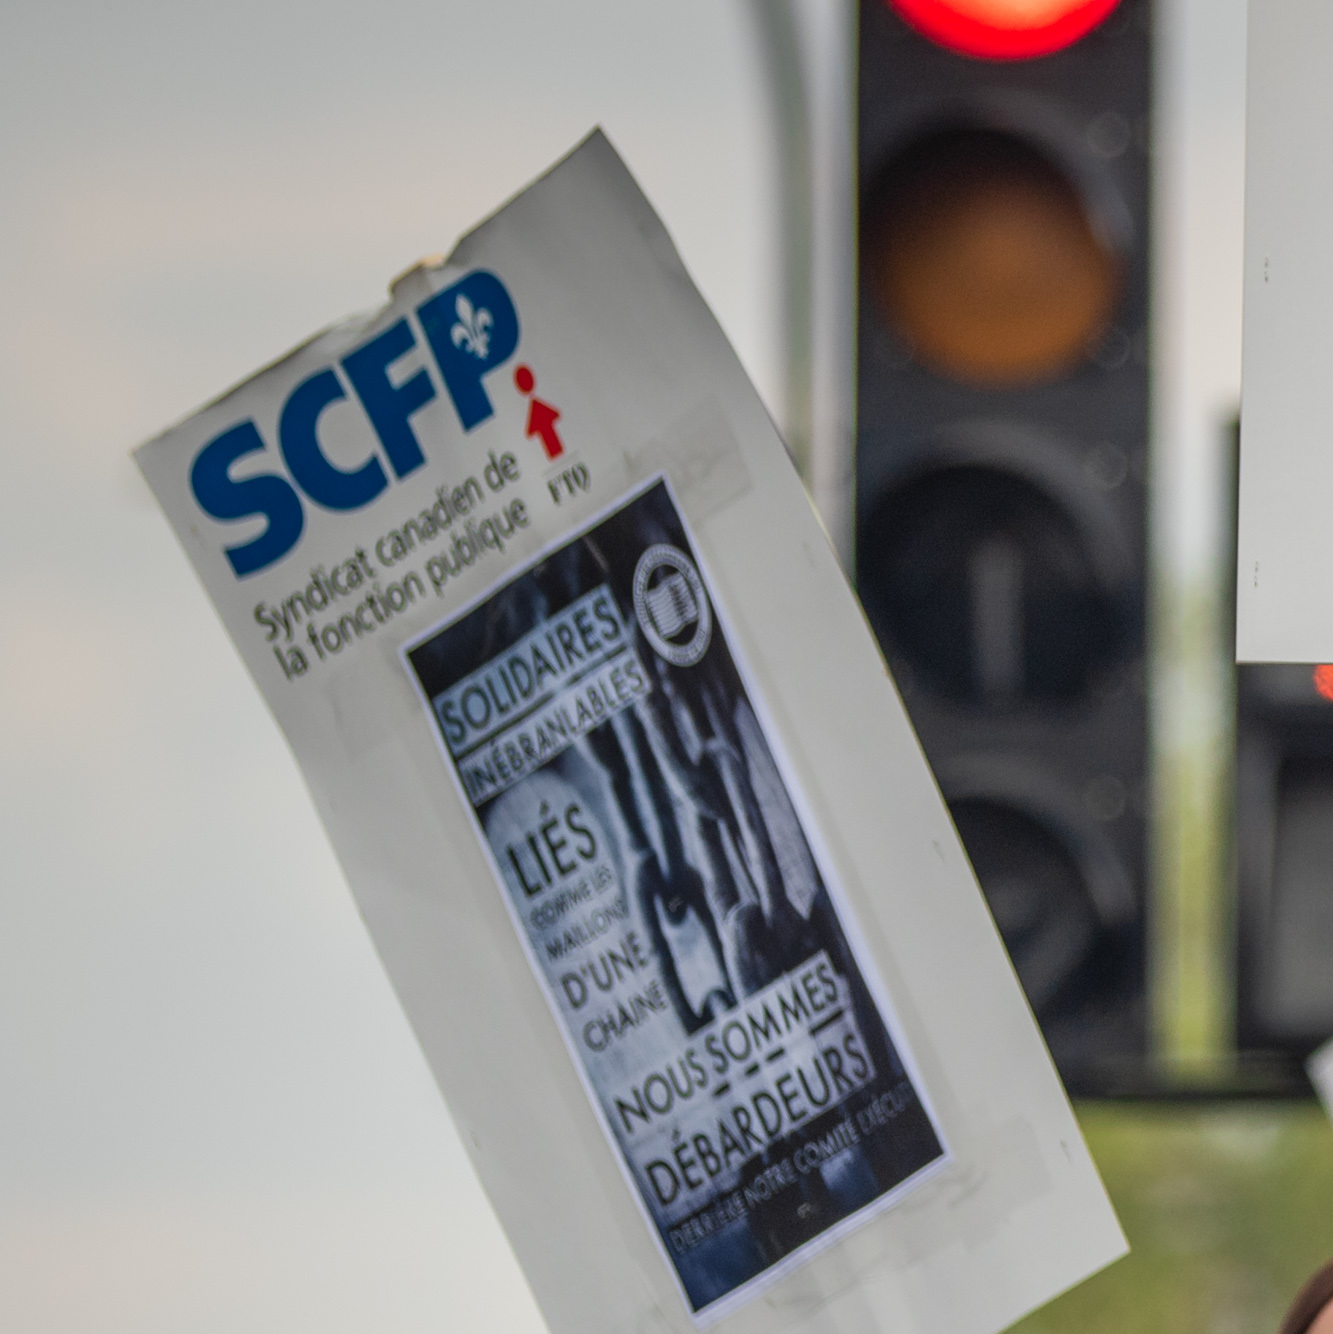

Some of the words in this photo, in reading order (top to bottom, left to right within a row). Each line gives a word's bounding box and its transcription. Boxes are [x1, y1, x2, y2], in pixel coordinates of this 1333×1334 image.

[188, 267, 521, 581] SCFP
[254, 544, 378, 642] Syndicat
[374, 475, 486, 569] canadien
[484, 449, 521, 493] de
[273, 643, 311, 681] la
[305, 571, 427, 662] fonction
[424, 498, 531, 597] publique
[441, 597, 621, 744] SOLIDAIRES
[464, 660, 645, 798] INÉBRANLABLES
[506, 800, 598, 898] LIÉS
[560, 931, 649, 1009] D'UNE
[613, 1048, 709, 1134] NOUS
[704, 961, 838, 1075] SOMMES
[644, 1031, 868, 1206] DÉBARDEURS
